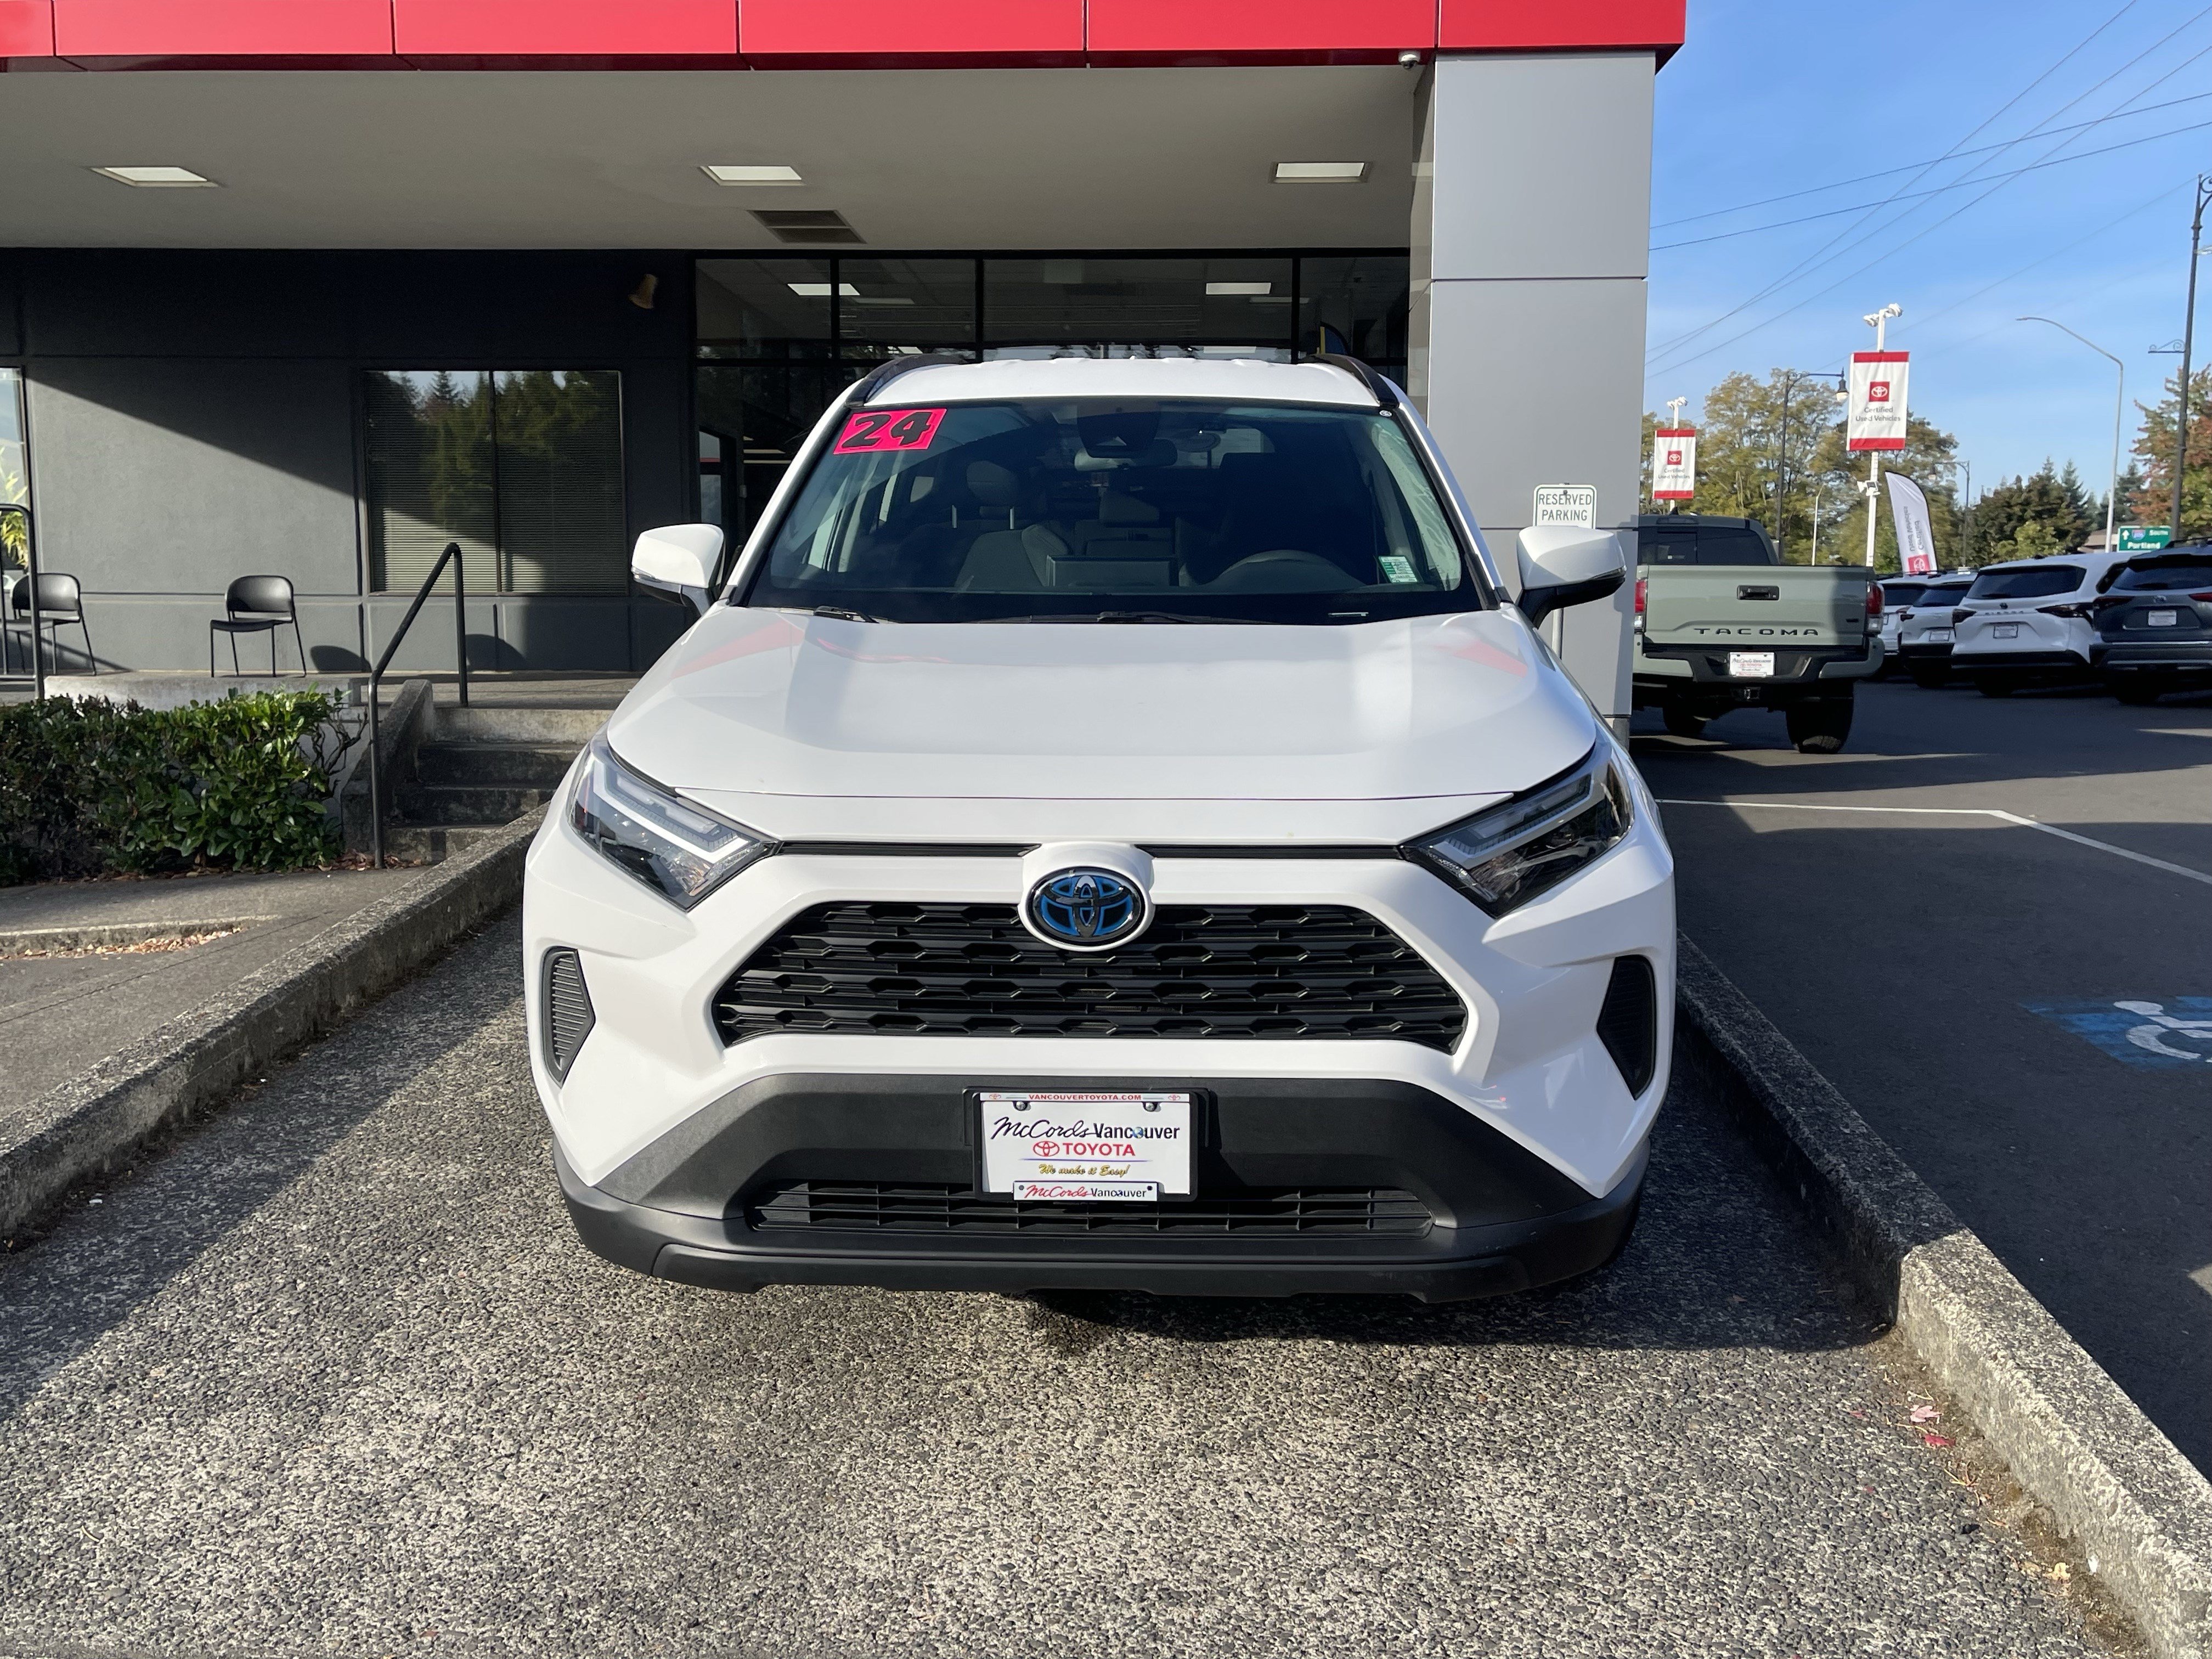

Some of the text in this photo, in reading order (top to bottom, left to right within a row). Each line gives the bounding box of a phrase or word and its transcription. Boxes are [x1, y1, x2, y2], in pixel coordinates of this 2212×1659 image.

[842, 412, 934, 448] 24
[1539, 494, 1592, 505] RESERVED
[1542, 510, 1587, 521] PARKING
[1063, 1143, 1136, 1156] TOYOTA
[1039, 1164, 1131, 1178] We make it Easy!
